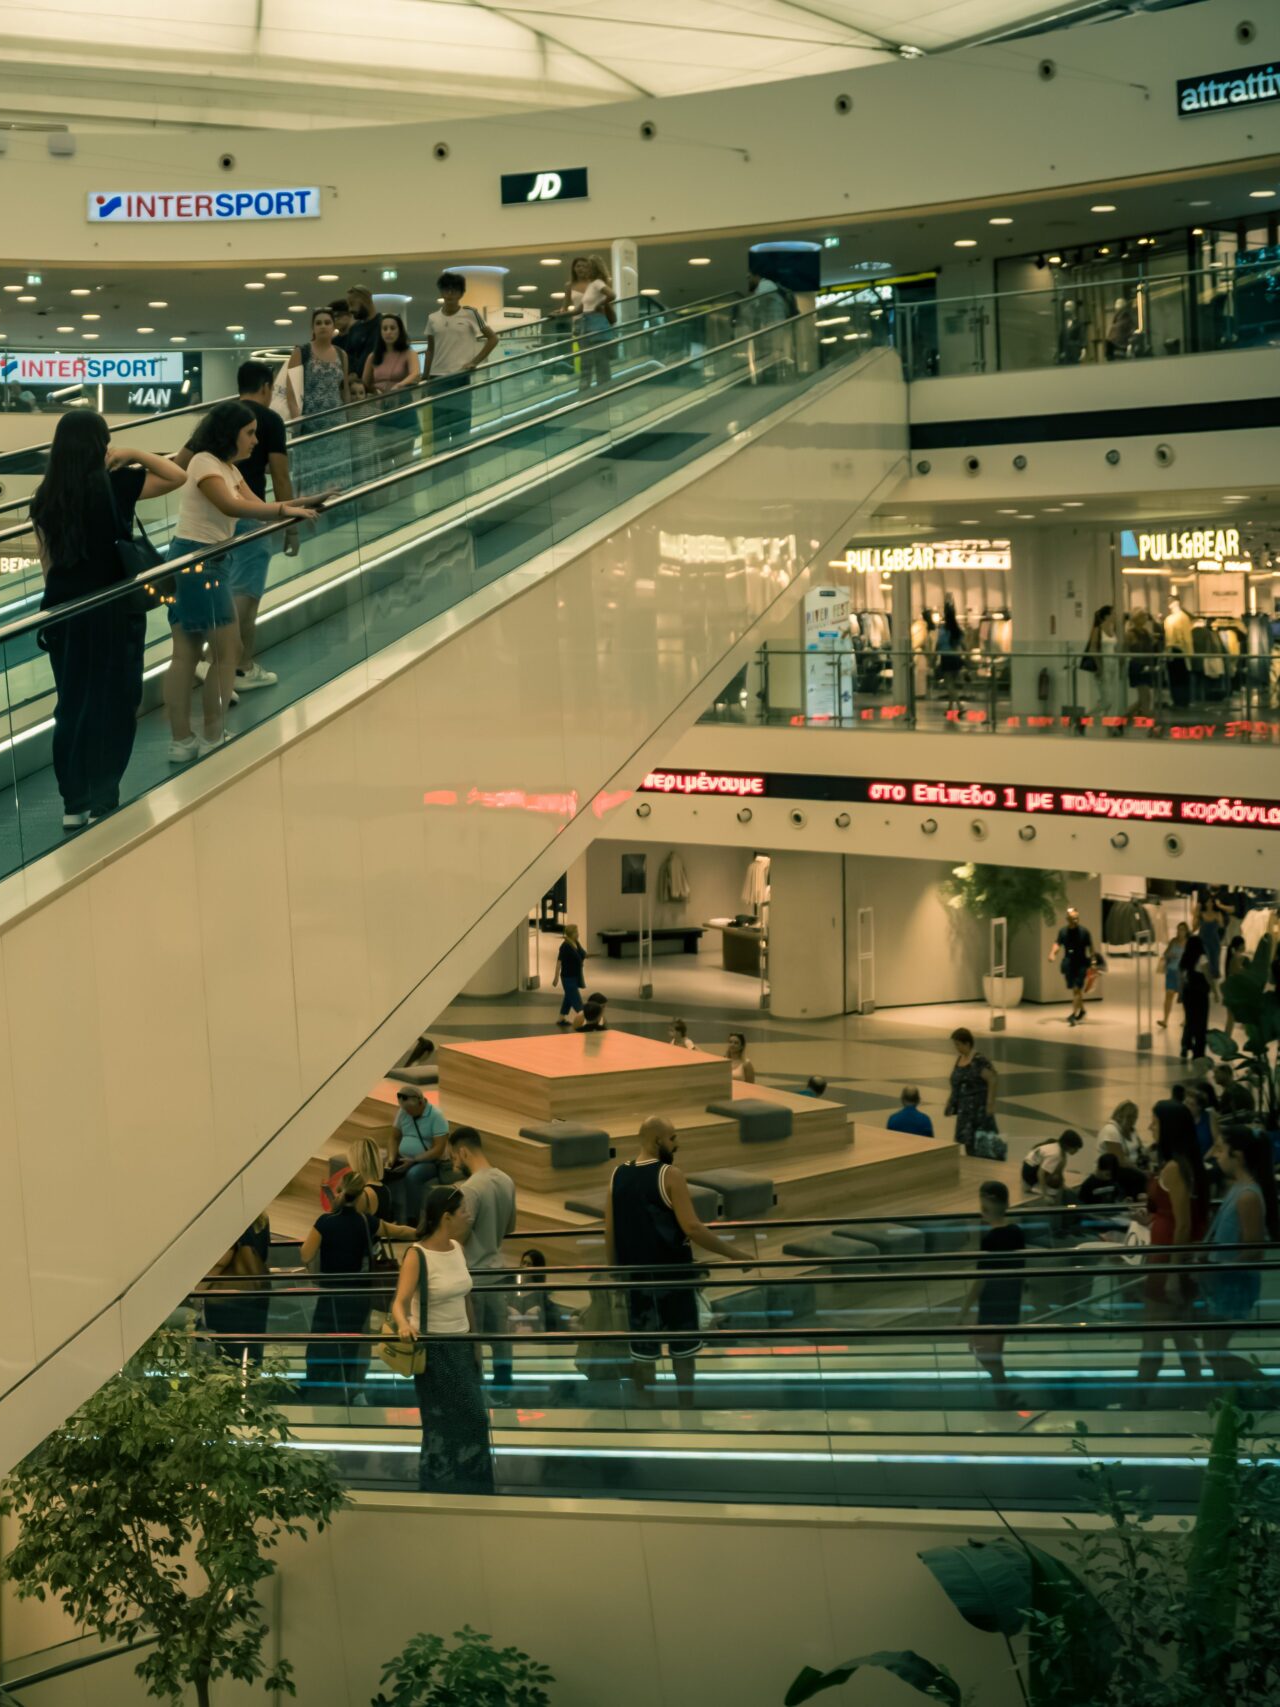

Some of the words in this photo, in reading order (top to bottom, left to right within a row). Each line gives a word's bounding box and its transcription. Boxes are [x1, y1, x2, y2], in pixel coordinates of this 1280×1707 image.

[526, 172, 562, 202] JD
[126, 190, 312, 218] INTERSPORT
[21, 359, 157, 378] INTERSPORT
[1139, 528, 1240, 561] PULL&BEAR
[846, 547, 935, 573] PULL&BEAR
[868, 783, 906, 800] στο
[913, 783, 996, 806] Επίπεδο
[1003, 787, 1018, 807] 1
[1025, 792, 1054, 811] με
